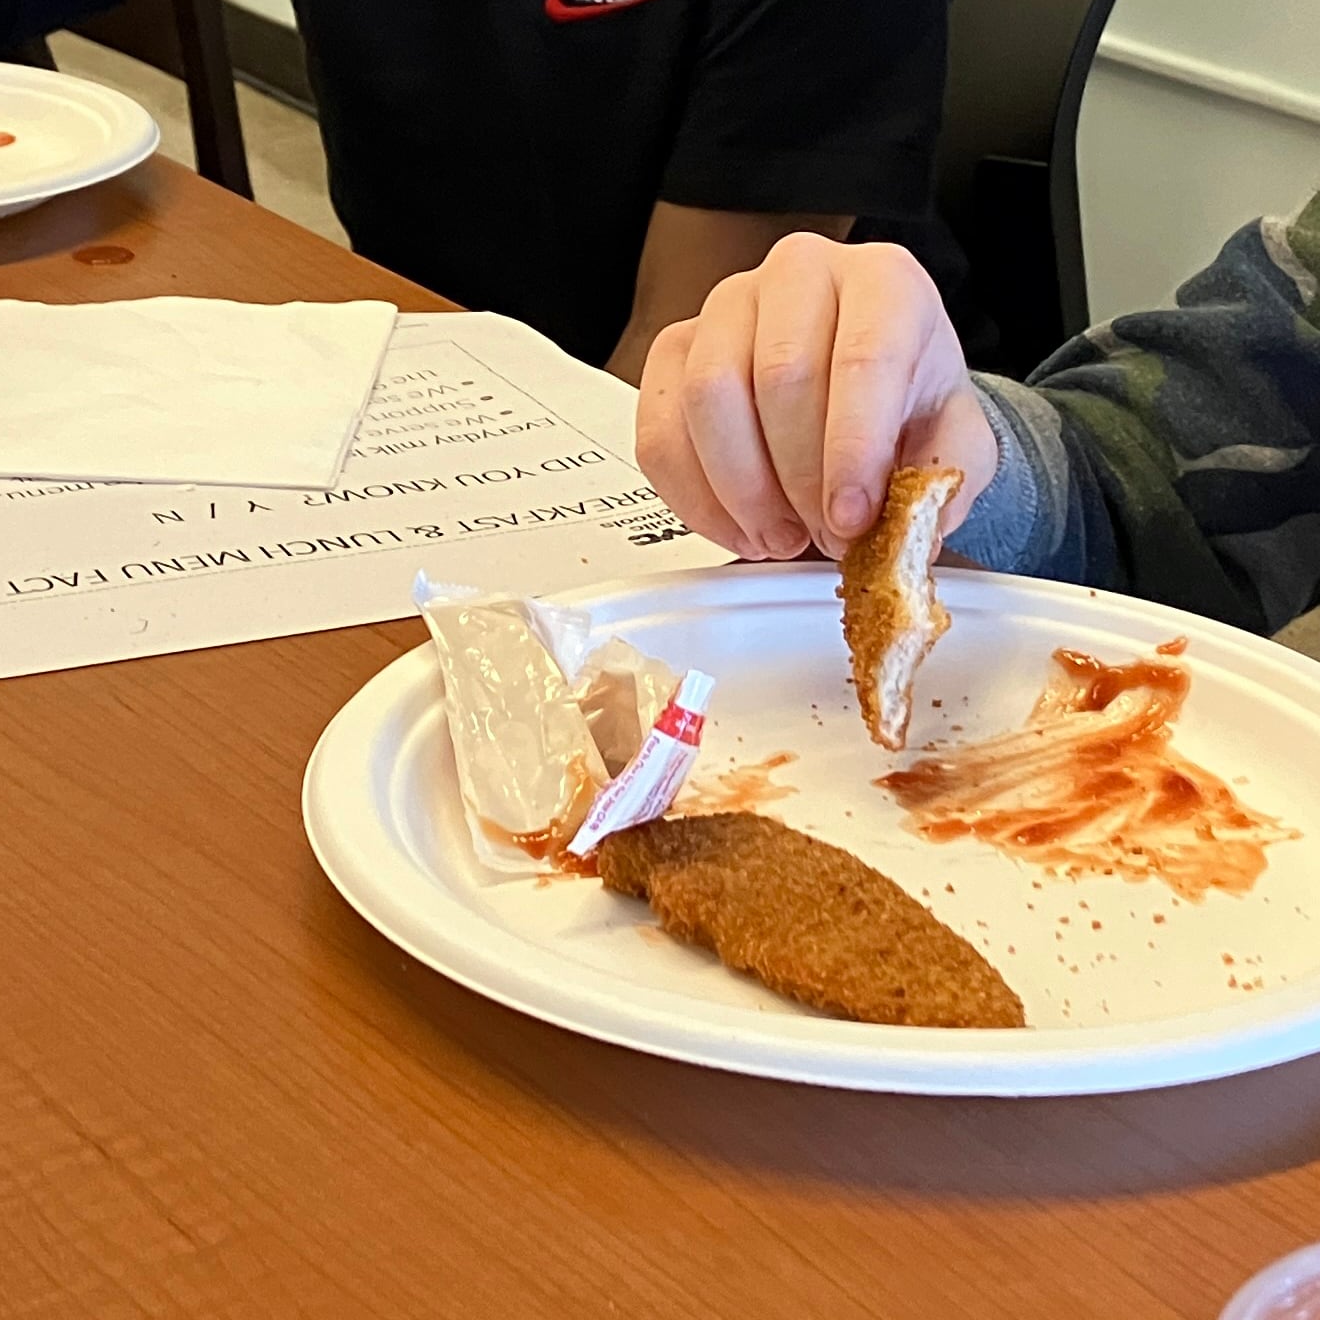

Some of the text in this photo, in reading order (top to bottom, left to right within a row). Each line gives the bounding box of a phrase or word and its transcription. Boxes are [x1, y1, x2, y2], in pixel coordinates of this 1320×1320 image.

[435, 417, 556, 444] Everyday
[369, 439, 426, 457] milk
[541, 450, 606, 472] DID
[455, 467, 537, 487] YOU
[303, 478, 448, 507] KNOW?
[247, 500, 274, 513] Y
[152, 510, 185, 524] N
[600, 509, 672, 528] chools
[6, 486, 659, 596] BREAKFAST & LUNCH MENU FACT
